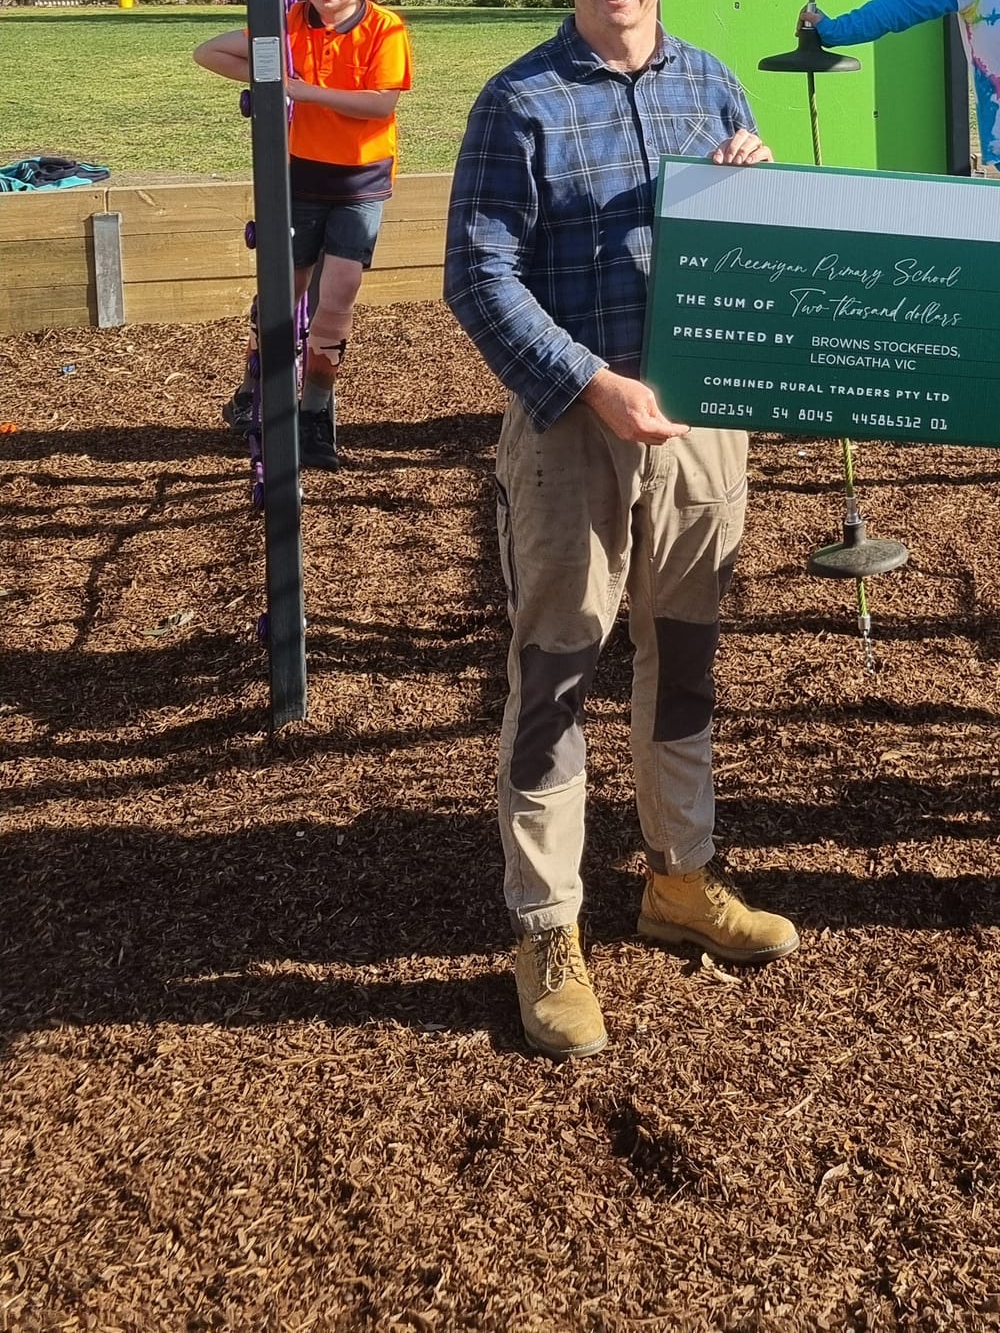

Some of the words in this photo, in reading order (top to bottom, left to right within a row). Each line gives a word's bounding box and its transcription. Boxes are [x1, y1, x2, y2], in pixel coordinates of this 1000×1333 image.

[679, 255, 709, 268] PAY
[714, 247, 808, 282] Meeniyan
[812, 253, 883, 288] Primary
[892, 258, 962, 287] School
[676, 293, 706, 306] THE
[714, 296, 746, 309] SUM
[753, 299, 775, 311] OF
[789, 288, 827, 318] Two
[829, 294, 907, 322] thousand
[904, 301, 962, 327] dollars
[673, 326, 767, 343] PRESENTED
[774, 333, 795, 345] BY
[811, 336, 870, 351] BROWNS
[873, 340, 961, 359] STOCKFEEDS,
[810, 353, 891, 369] LEONGATHA
[894, 358, 917, 370] VIC
[703, 376, 774, 390] COMBINED
[780, 381, 824, 394] RURAL
[829, 385, 890, 398] TRADERS
[896, 390, 920, 400] PTY
[926, 392, 950, 402] LTD
[700, 402, 753, 416] 002154
[771, 406, 789, 419] 54
[798, 408, 833, 422] 8045
[852, 412, 921, 429] 44586512
[931, 417, 948, 430] 01
